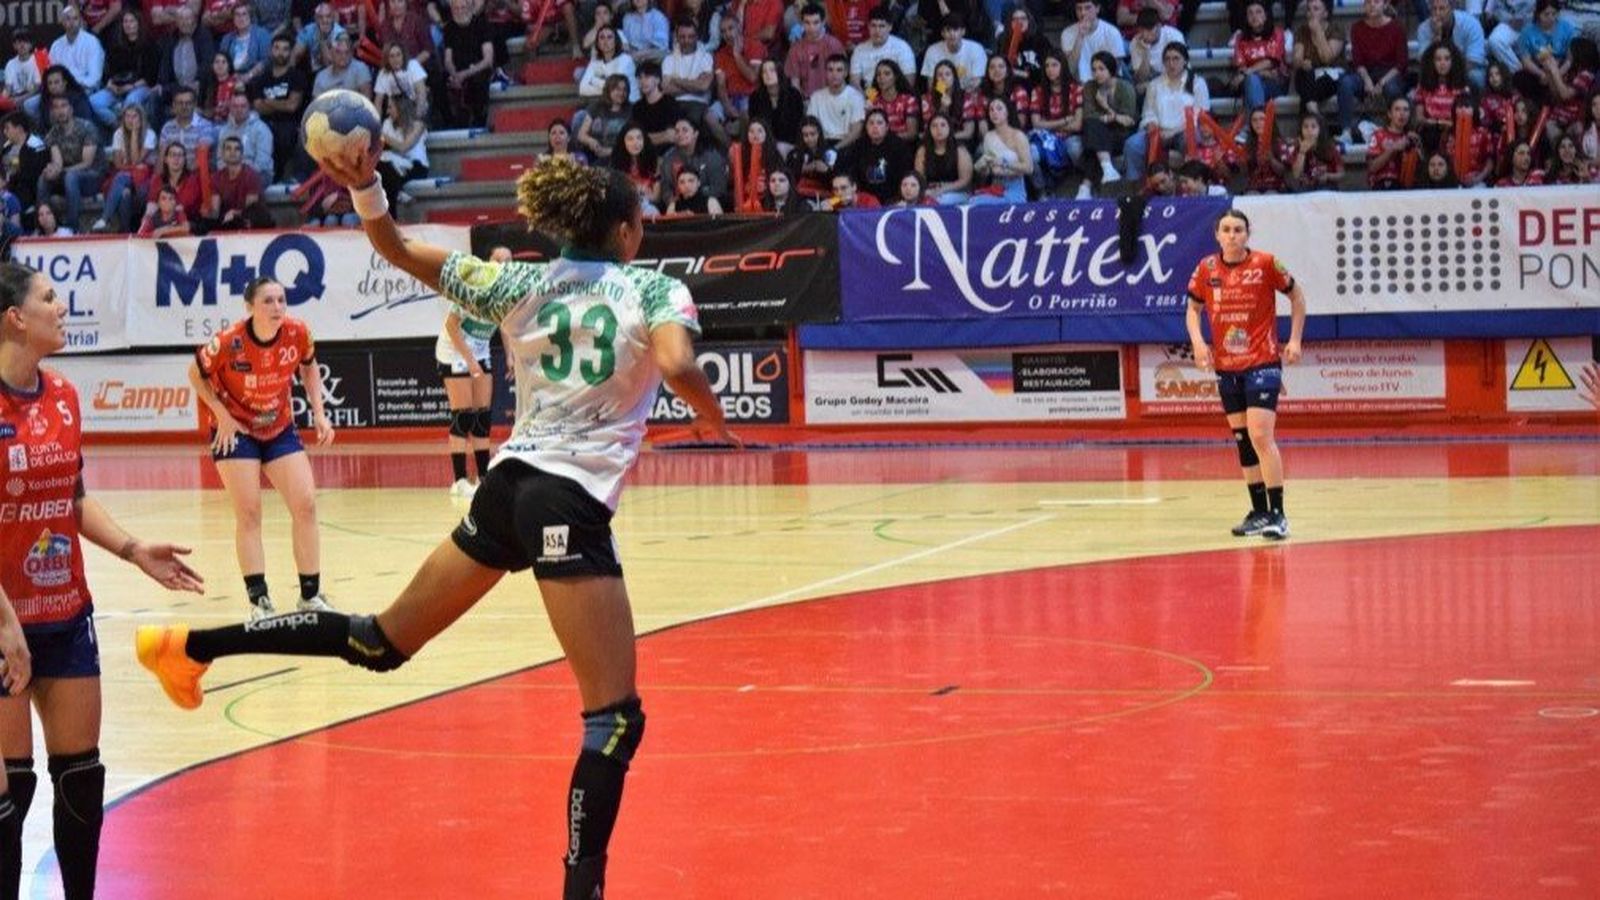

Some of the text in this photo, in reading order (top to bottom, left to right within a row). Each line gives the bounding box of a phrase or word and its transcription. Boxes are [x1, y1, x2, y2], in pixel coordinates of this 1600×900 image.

[876, 205, 1177, 313] Nattex
[1242, 269, 1263, 284] 22
[536, 279, 624, 302] NASCIMENTO
[1029, 296, 1042, 310] O
[1049, 293, 1117, 309] Porriño
[538, 302, 618, 386] 33
[280, 346, 298, 365] 20
[815, 395, 929, 407] Grupo Godoy Maceira
[57, 400, 73, 426] 5
[29, 441, 63, 456] XUNTA
[544, 531, 567, 548] ASA
[244, 613, 320, 633] Kempa
[568, 788, 584, 866] Kempa
